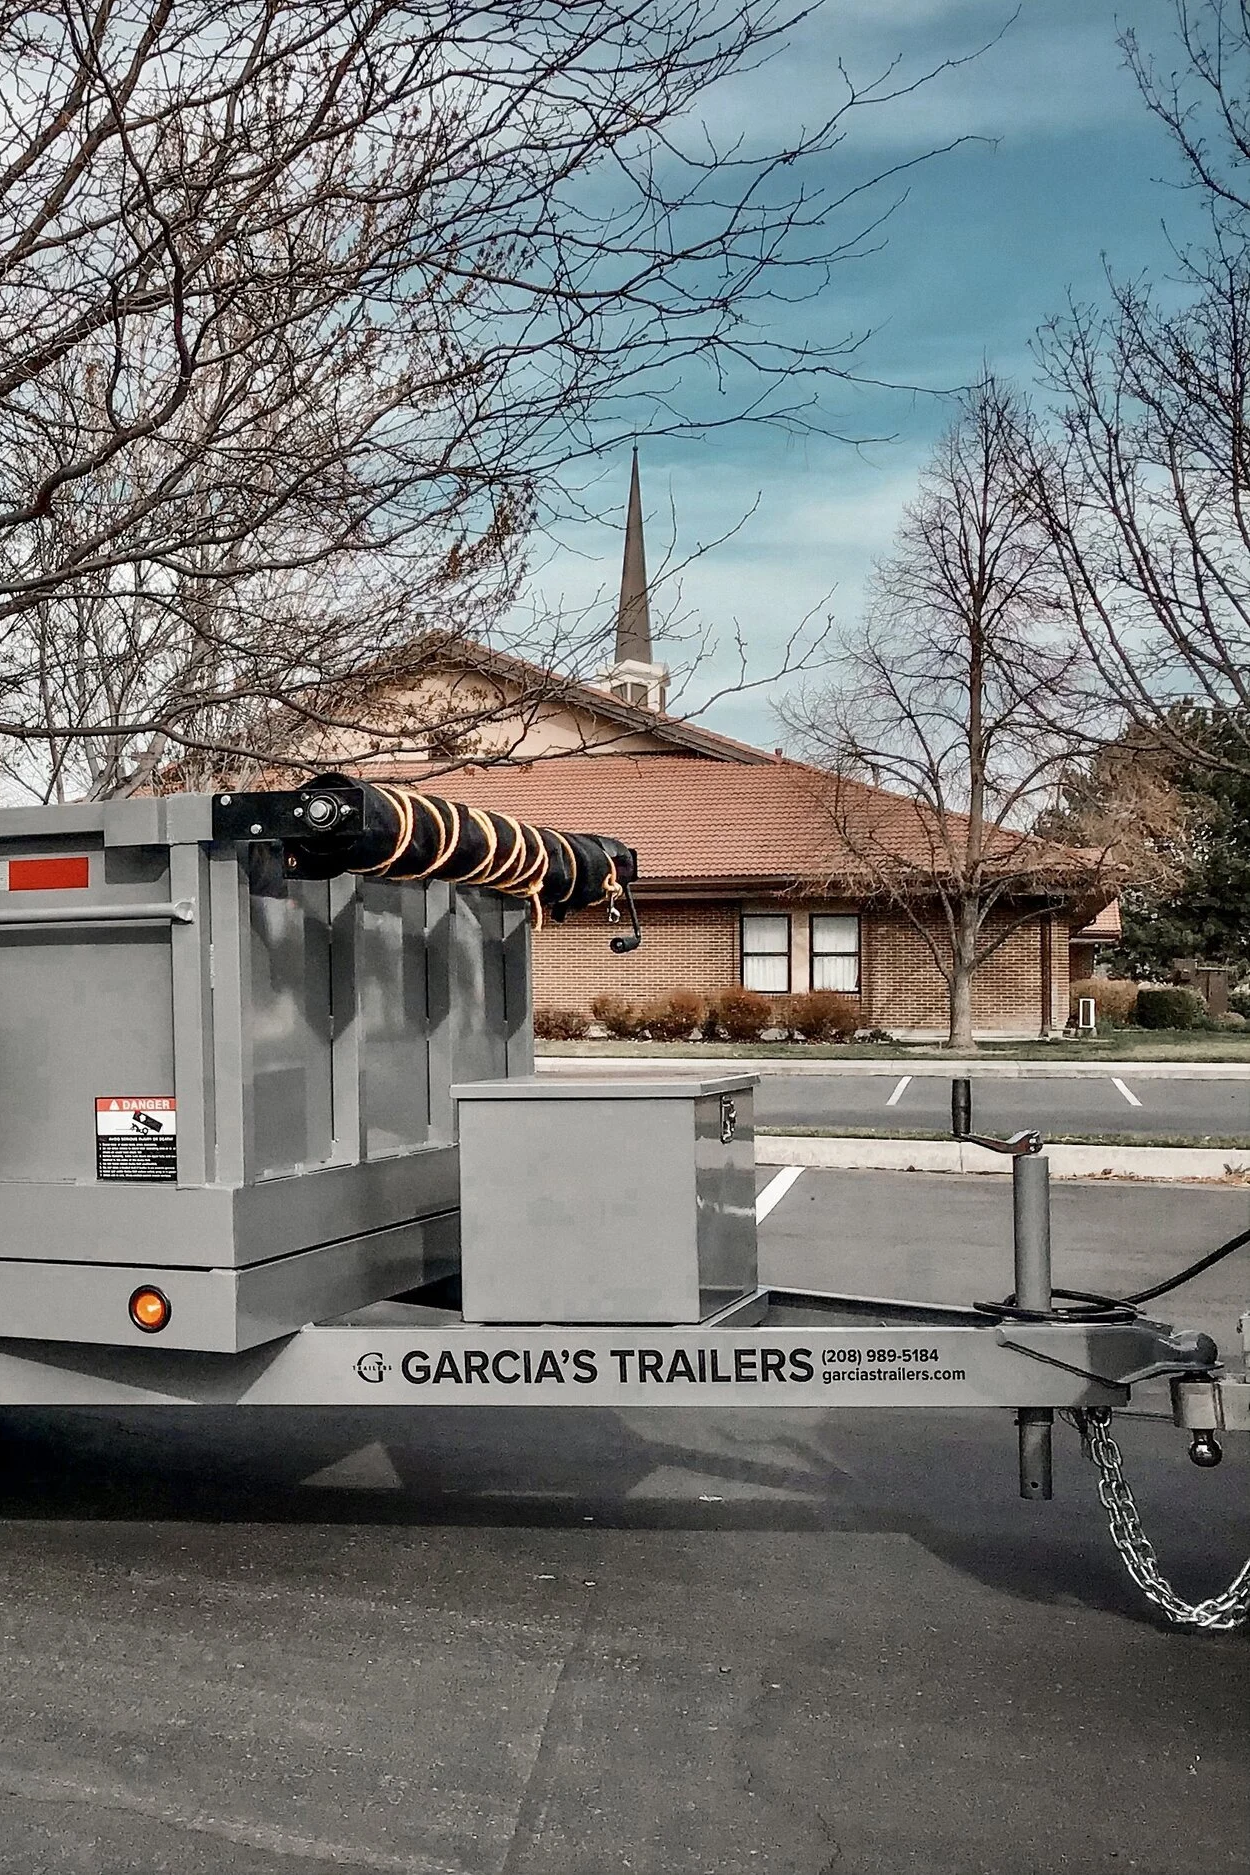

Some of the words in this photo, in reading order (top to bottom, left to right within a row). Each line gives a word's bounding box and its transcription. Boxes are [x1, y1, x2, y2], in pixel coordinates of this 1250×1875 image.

[122, 1099, 170, 1110] DANGER
[821, 1349, 862, 1366] (208)
[866, 1348, 939, 1362] 989-5184
[401, 1350, 598, 1384] GARCIA'S
[610, 1349, 815, 1383] TRAILERS
[822, 1367, 966, 1384] garciastrailers.com
